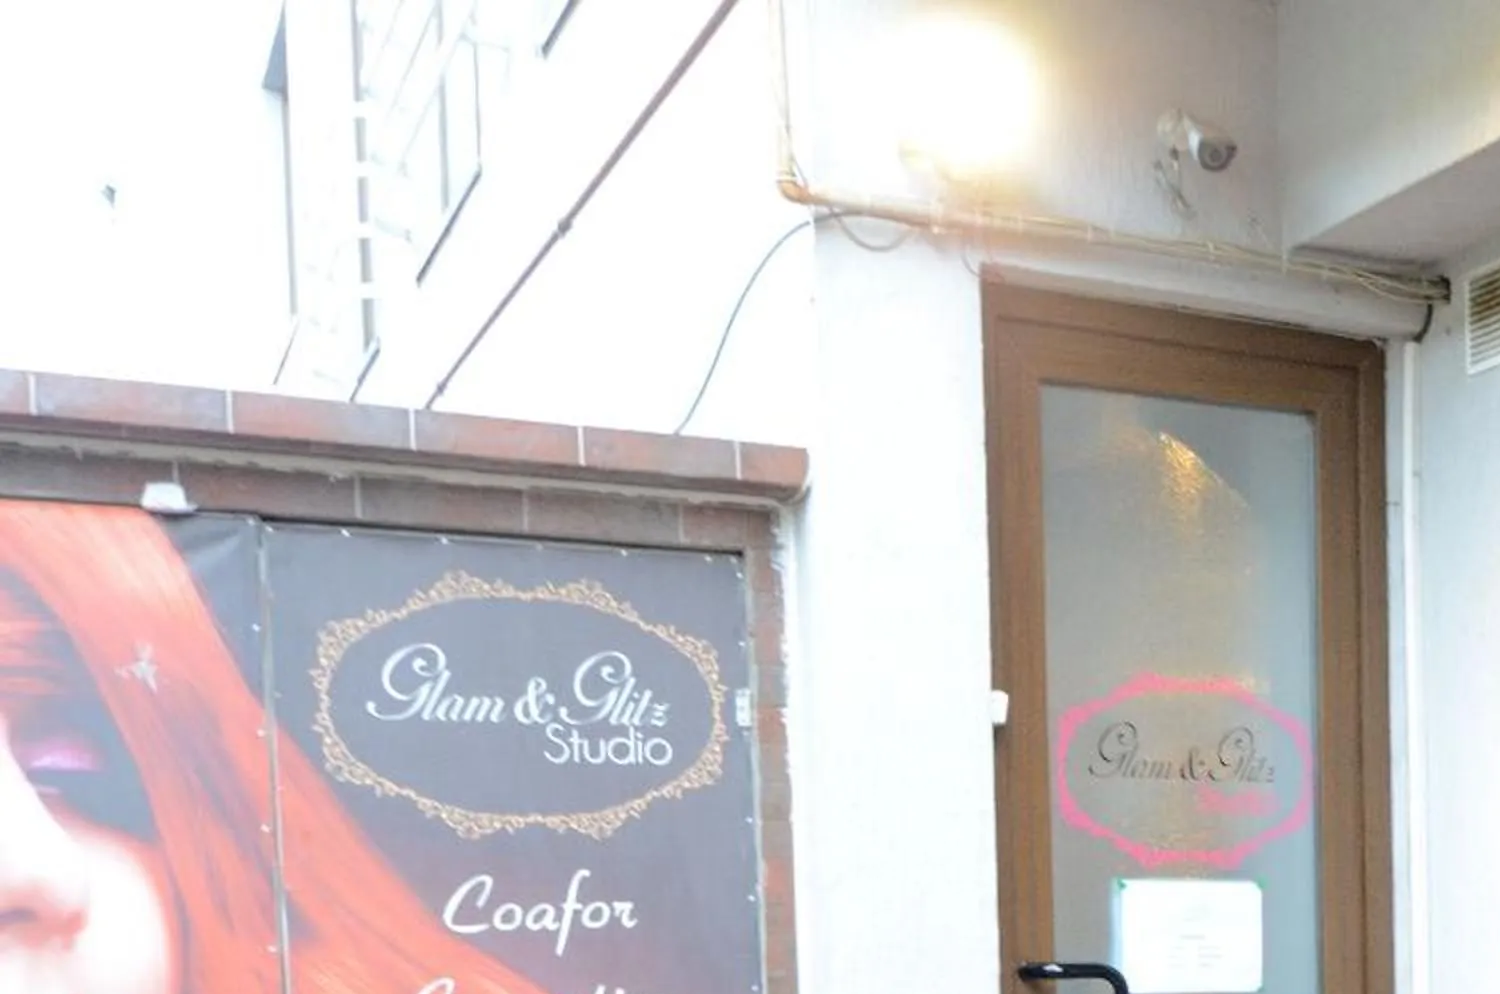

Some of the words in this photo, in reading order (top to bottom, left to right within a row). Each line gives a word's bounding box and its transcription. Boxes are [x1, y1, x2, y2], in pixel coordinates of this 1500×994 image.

[366, 643, 505, 721] Glam
[514, 677, 555, 725] &
[558, 651, 672, 727] Glitz
[544, 722, 673, 766] Studio
[443, 869, 638, 957] Coafor
